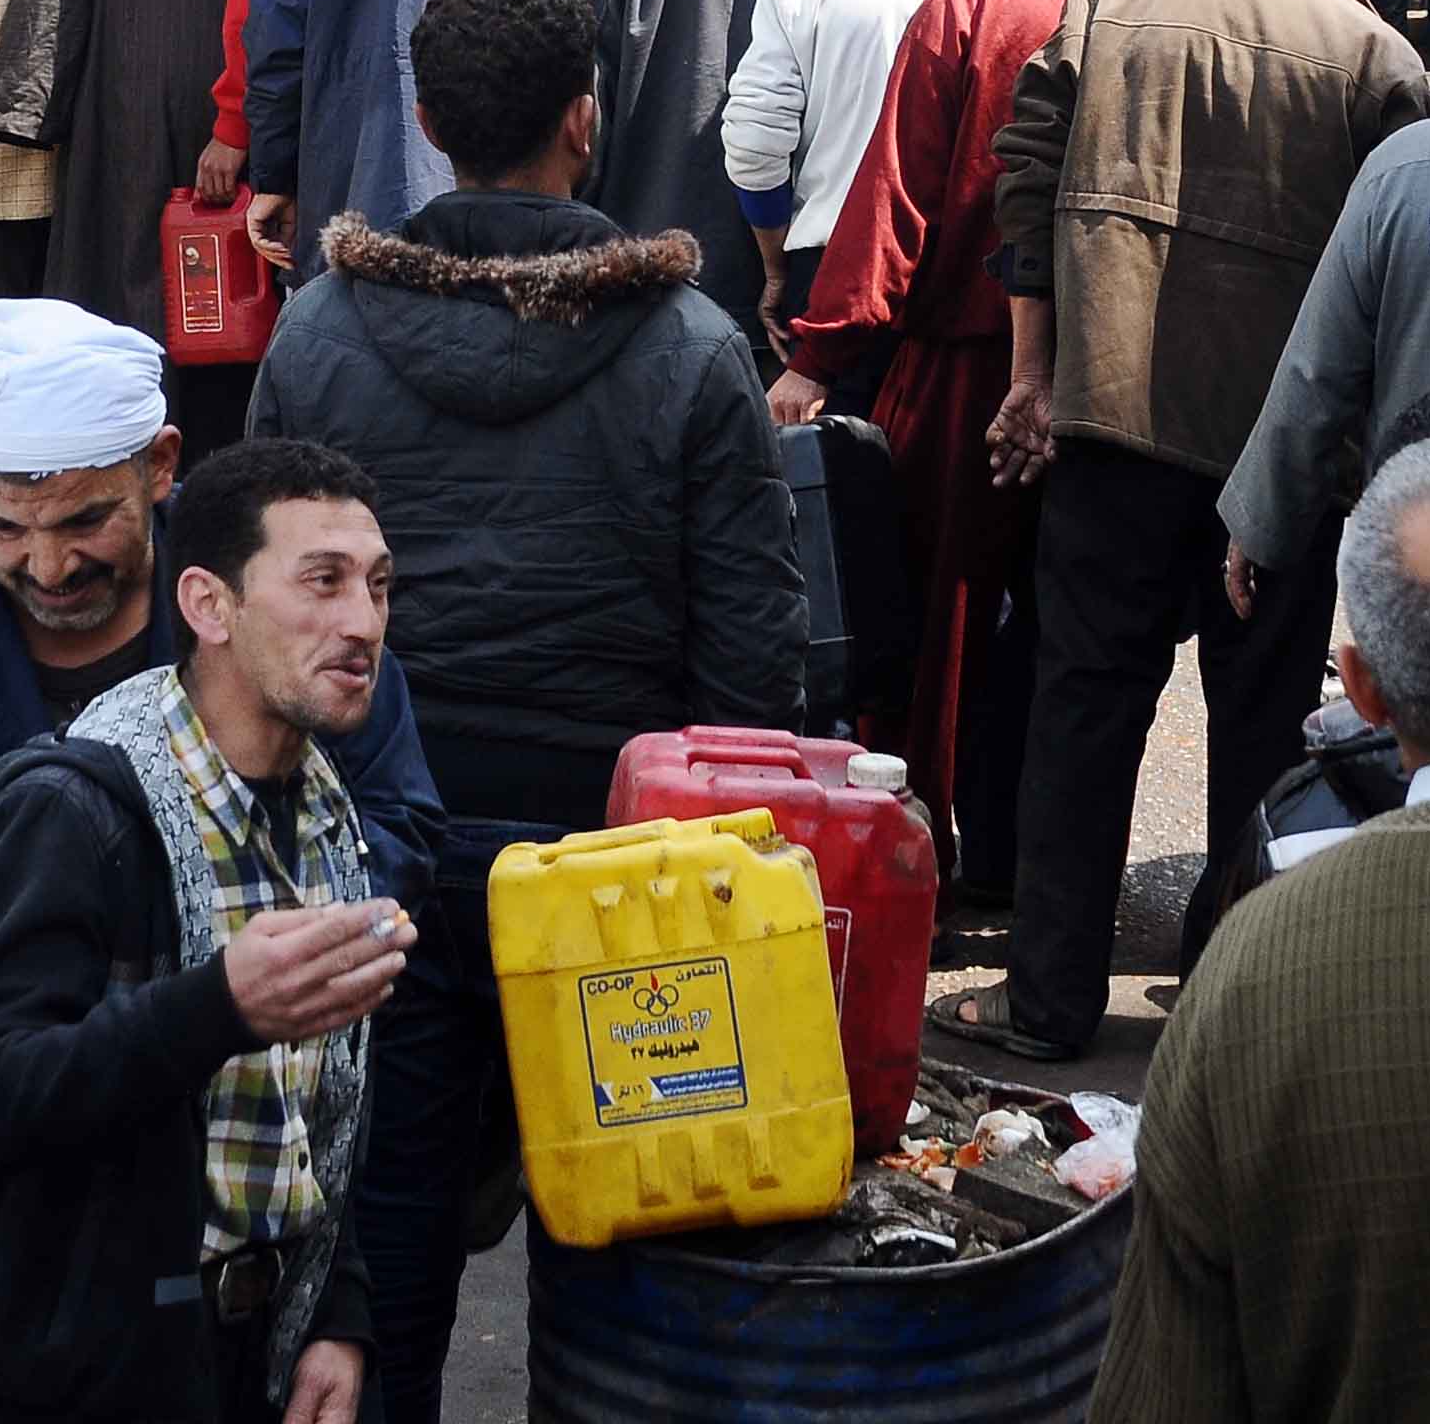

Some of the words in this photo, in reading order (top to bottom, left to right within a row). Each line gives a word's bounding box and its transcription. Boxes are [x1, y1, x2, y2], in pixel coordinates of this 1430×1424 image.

[675, 963, 723, 982] التعاون
[587, 976, 634, 995] CO-OP
[611, 1014, 689, 1044] Hydraulic
[689, 1007, 712, 1032] 37
[648, 1039, 700, 1059] هيدروليك
